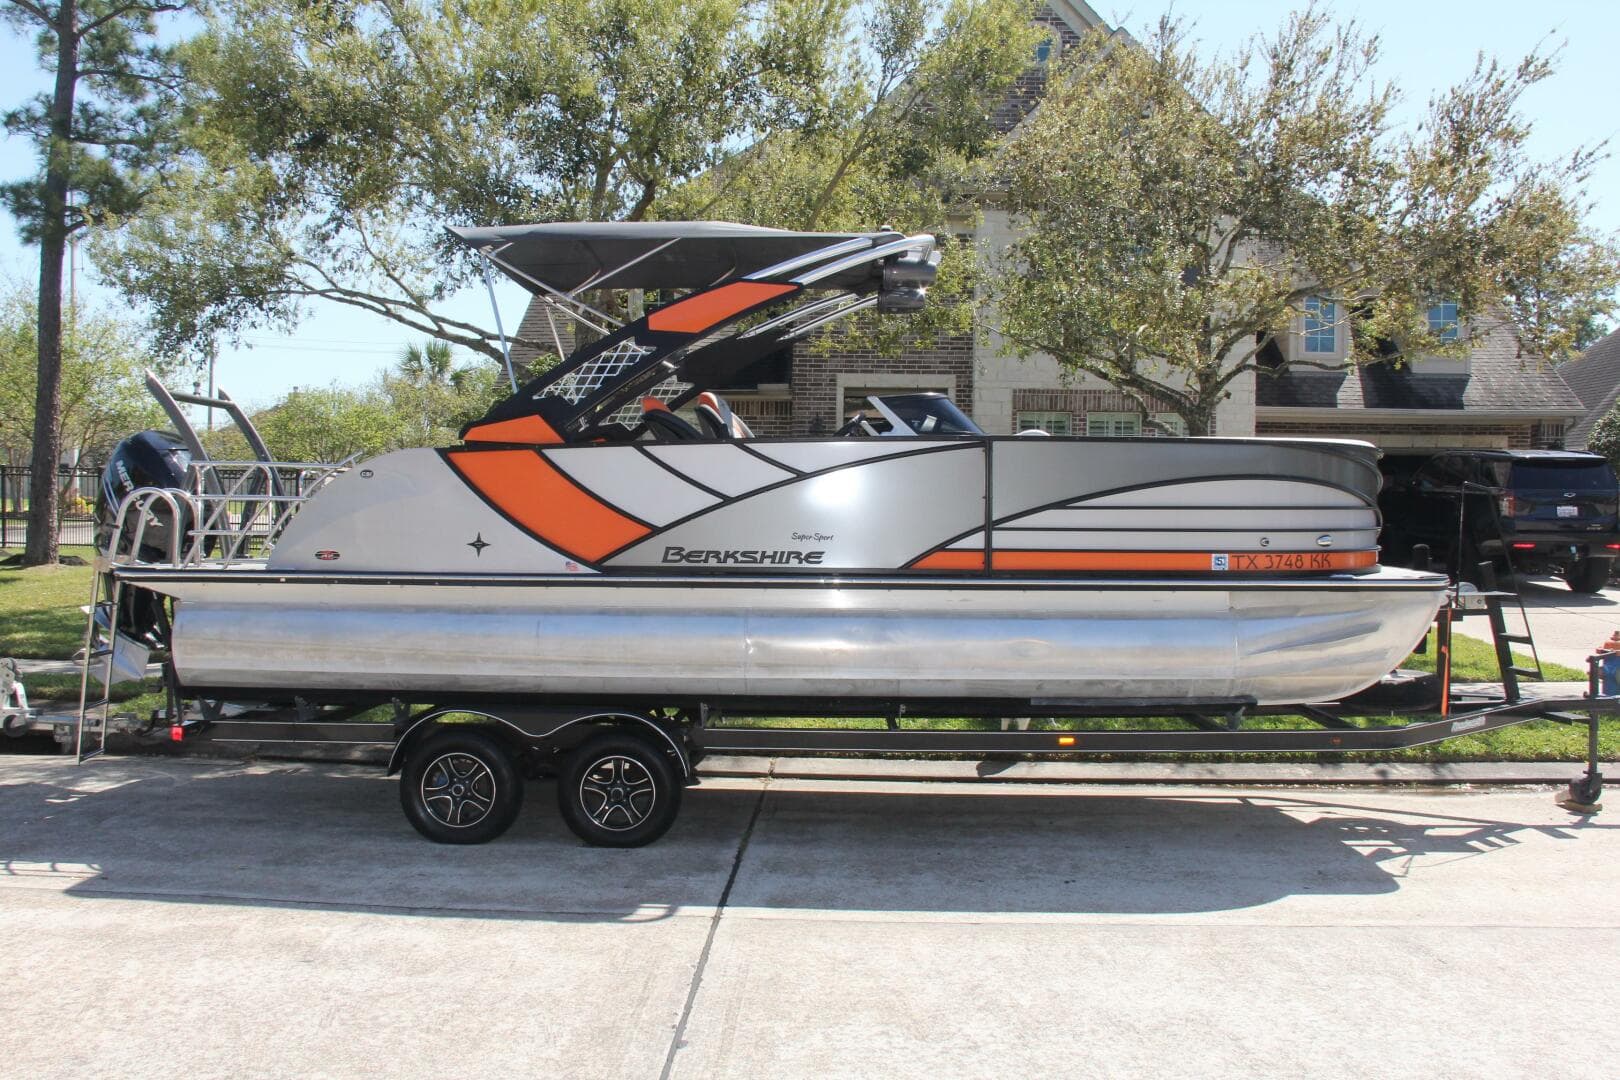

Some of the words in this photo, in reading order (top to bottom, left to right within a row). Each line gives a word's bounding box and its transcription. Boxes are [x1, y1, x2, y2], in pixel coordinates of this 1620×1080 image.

[813, 532, 834, 542] Sport
[1232, 555, 1258, 569] TX
[1264, 554, 1304, 569] 3748
[1310, 554, 1331, 569] KK
